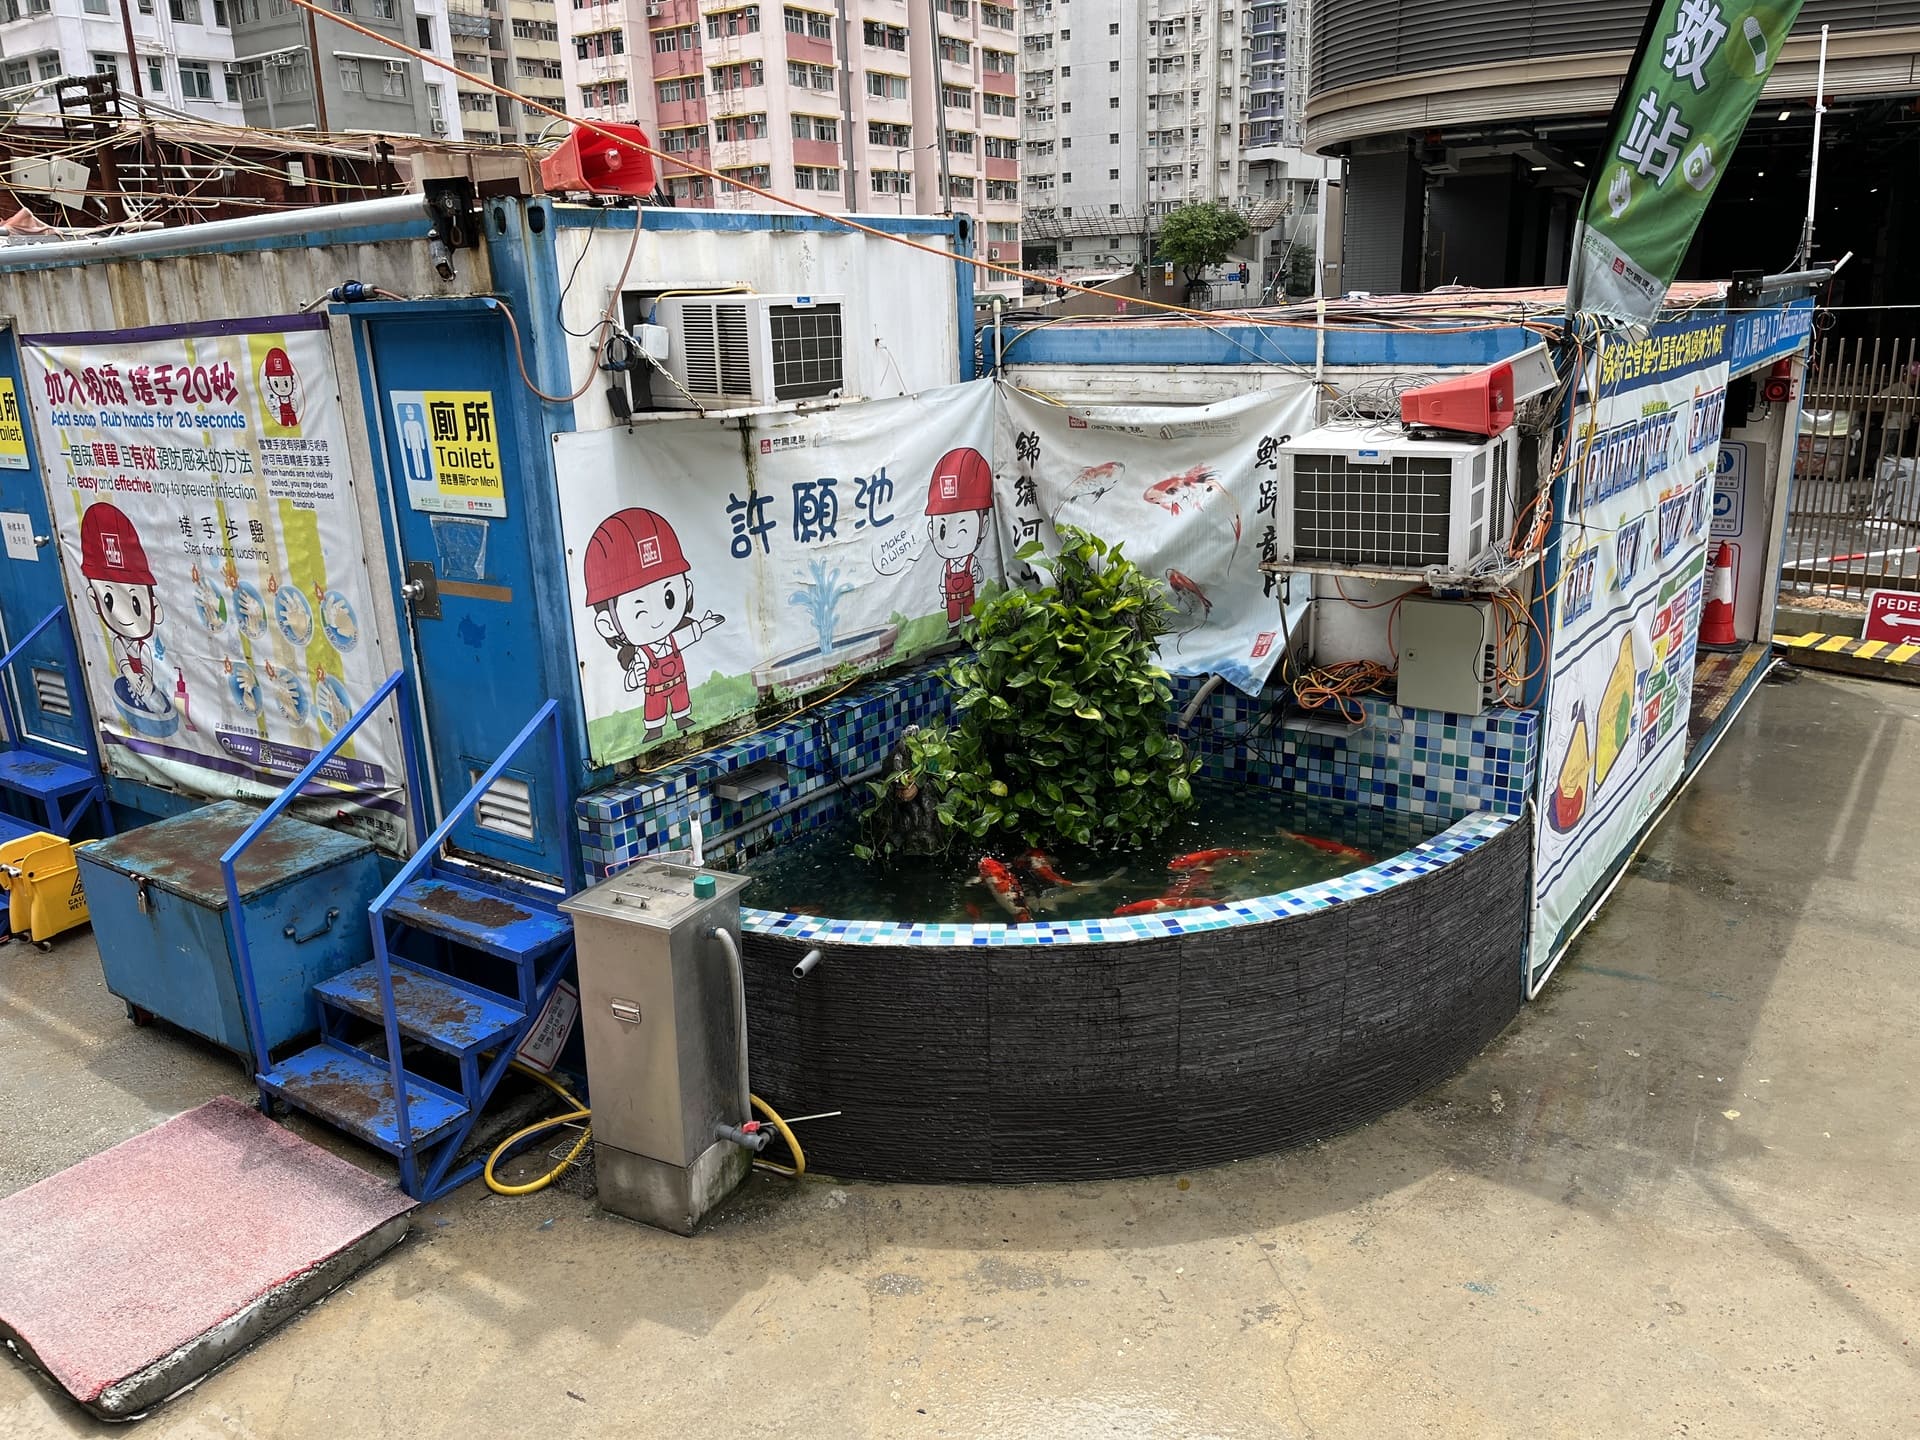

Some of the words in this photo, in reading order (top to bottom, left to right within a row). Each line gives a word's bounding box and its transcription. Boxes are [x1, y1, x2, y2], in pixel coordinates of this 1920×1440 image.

[0, 391, 18, 421] 所
[51, 412, 71, 428] Add
[100, 412, 122, 428] Rub
[124, 412, 155, 428] hands
[156, 412, 174, 428] for
[176, 411, 193, 428] 20
[194, 411, 246, 429] seconds
[430, 401, 491, 442] 廁所
[0, 425, 22, 441] oilet
[435, 447, 495, 469] Toilet
[262, 468, 279, 476] When
[279, 469, 295, 477] hands
[306, 470, 315, 478] not
[316, 470, 333, 480] visibly
[290, 481, 300, 489] you
[301, 481, 312, 489] may
[66, 474, 78, 486] An
[77, 476, 99, 493] easy
[99, 475, 115, 491] and
[114, 475, 152, 493] effective
[151, 481, 170, 498] way
[170, 481, 180, 495] to
[181, 483, 216, 500] prevent
[215, 481, 257, 500] infection
[269, 489, 284, 497] them
[726, 467, 895, 559] 許願池
[183, 541, 201, 556] Step
[202, 543, 214, 556] for
[216, 545, 235, 558] hand
[236, 547, 270, 564] washing
[881, 530, 907, 554] Make
[68, 896, 85, 906] CAU
